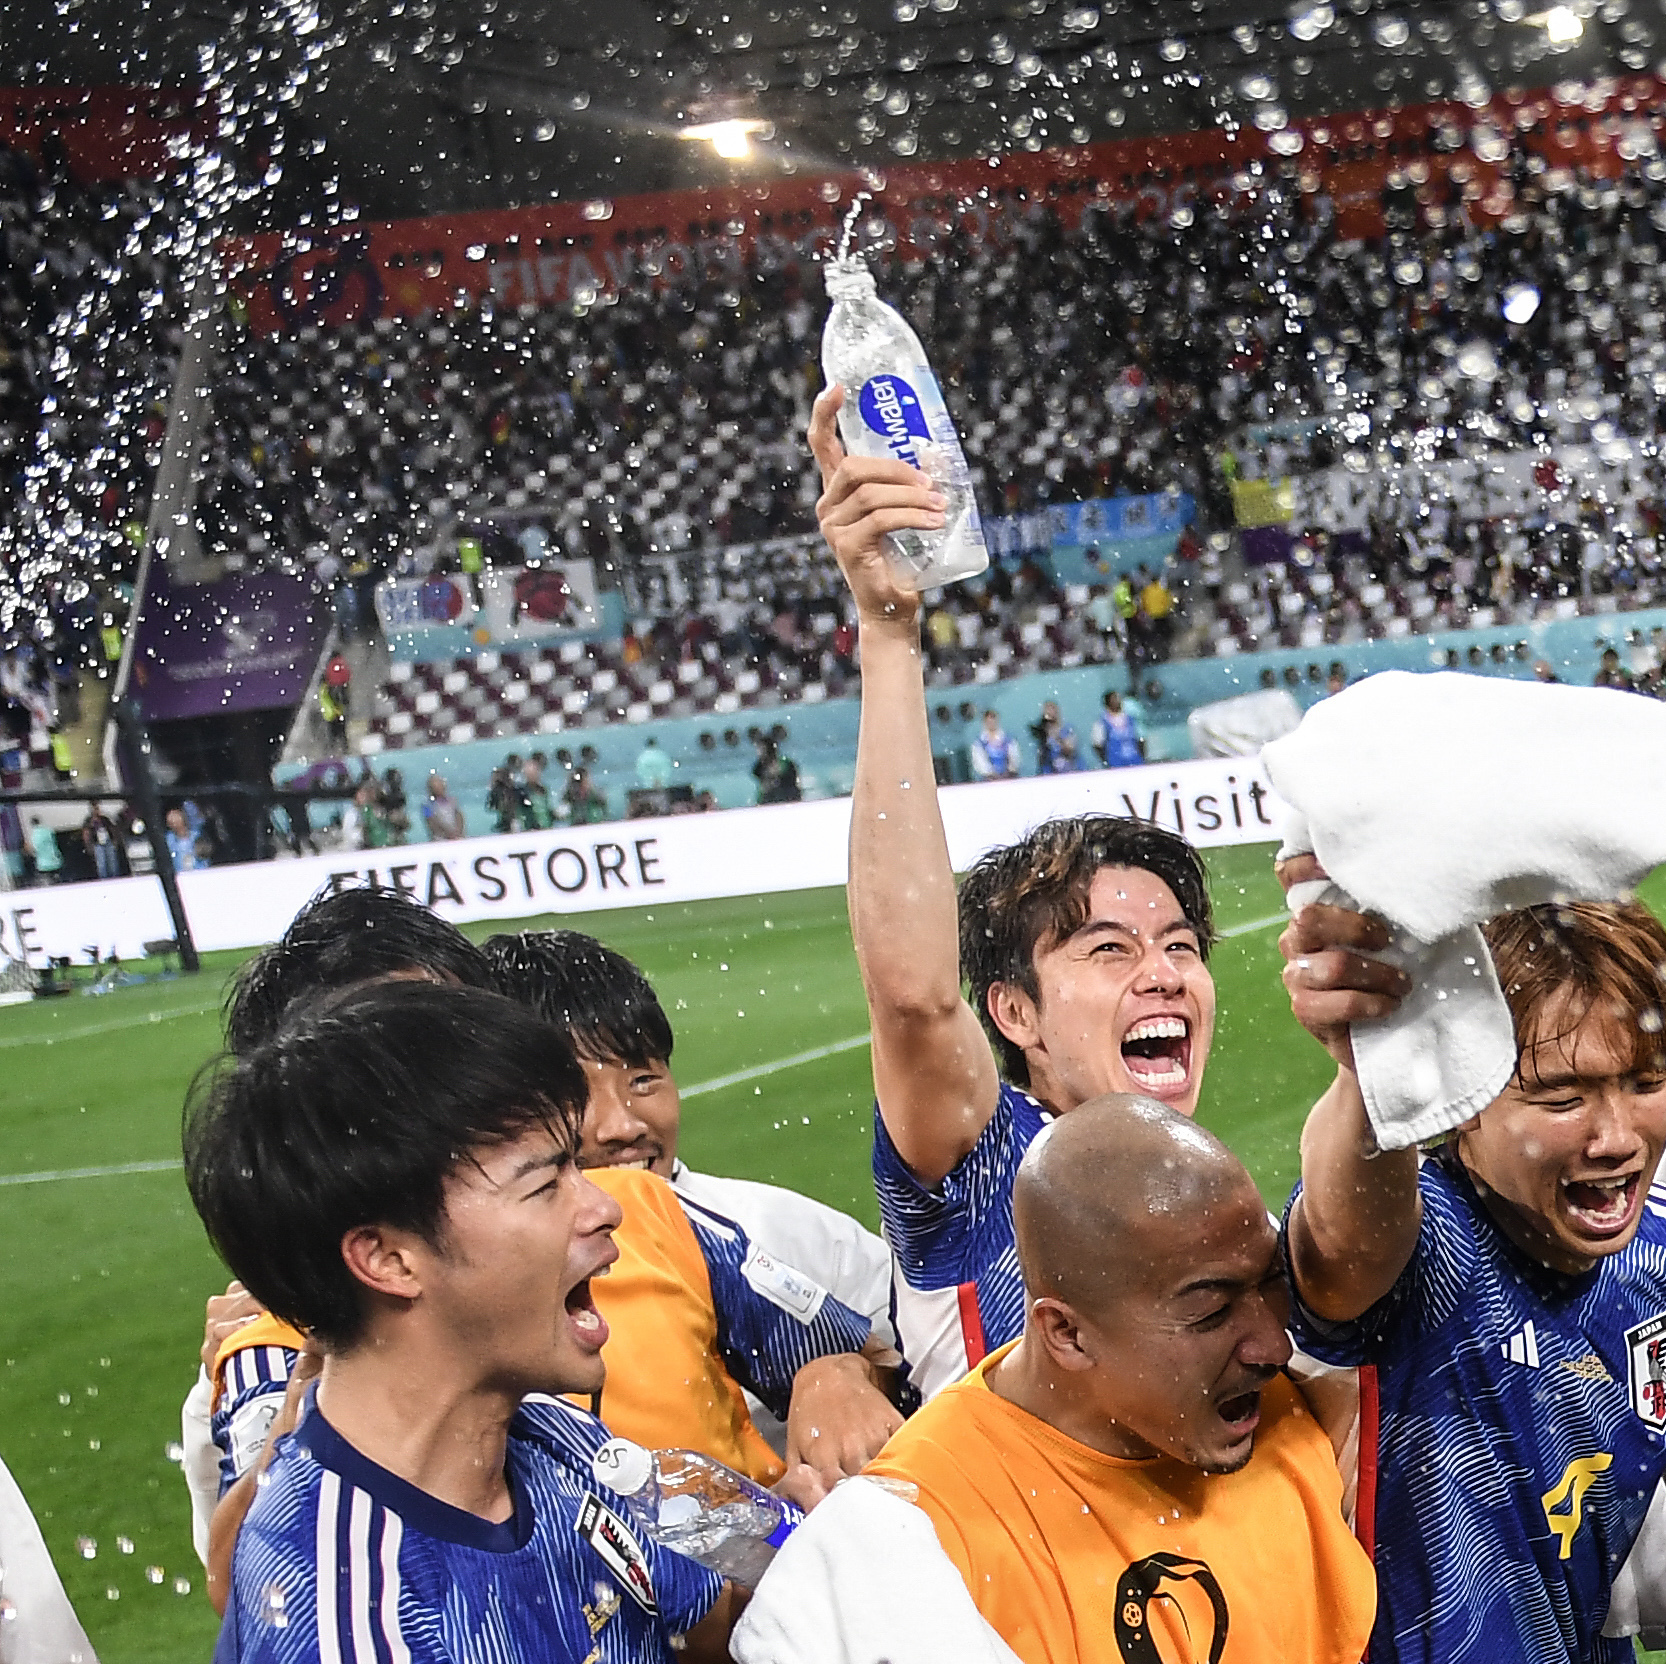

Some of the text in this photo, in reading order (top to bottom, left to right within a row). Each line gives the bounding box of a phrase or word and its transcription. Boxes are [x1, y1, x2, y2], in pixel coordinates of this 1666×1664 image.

[1122, 775, 1272, 832] Visit
[478, 838, 666, 901] STORE
[1637, 1320, 1664, 1340] JAPAN
